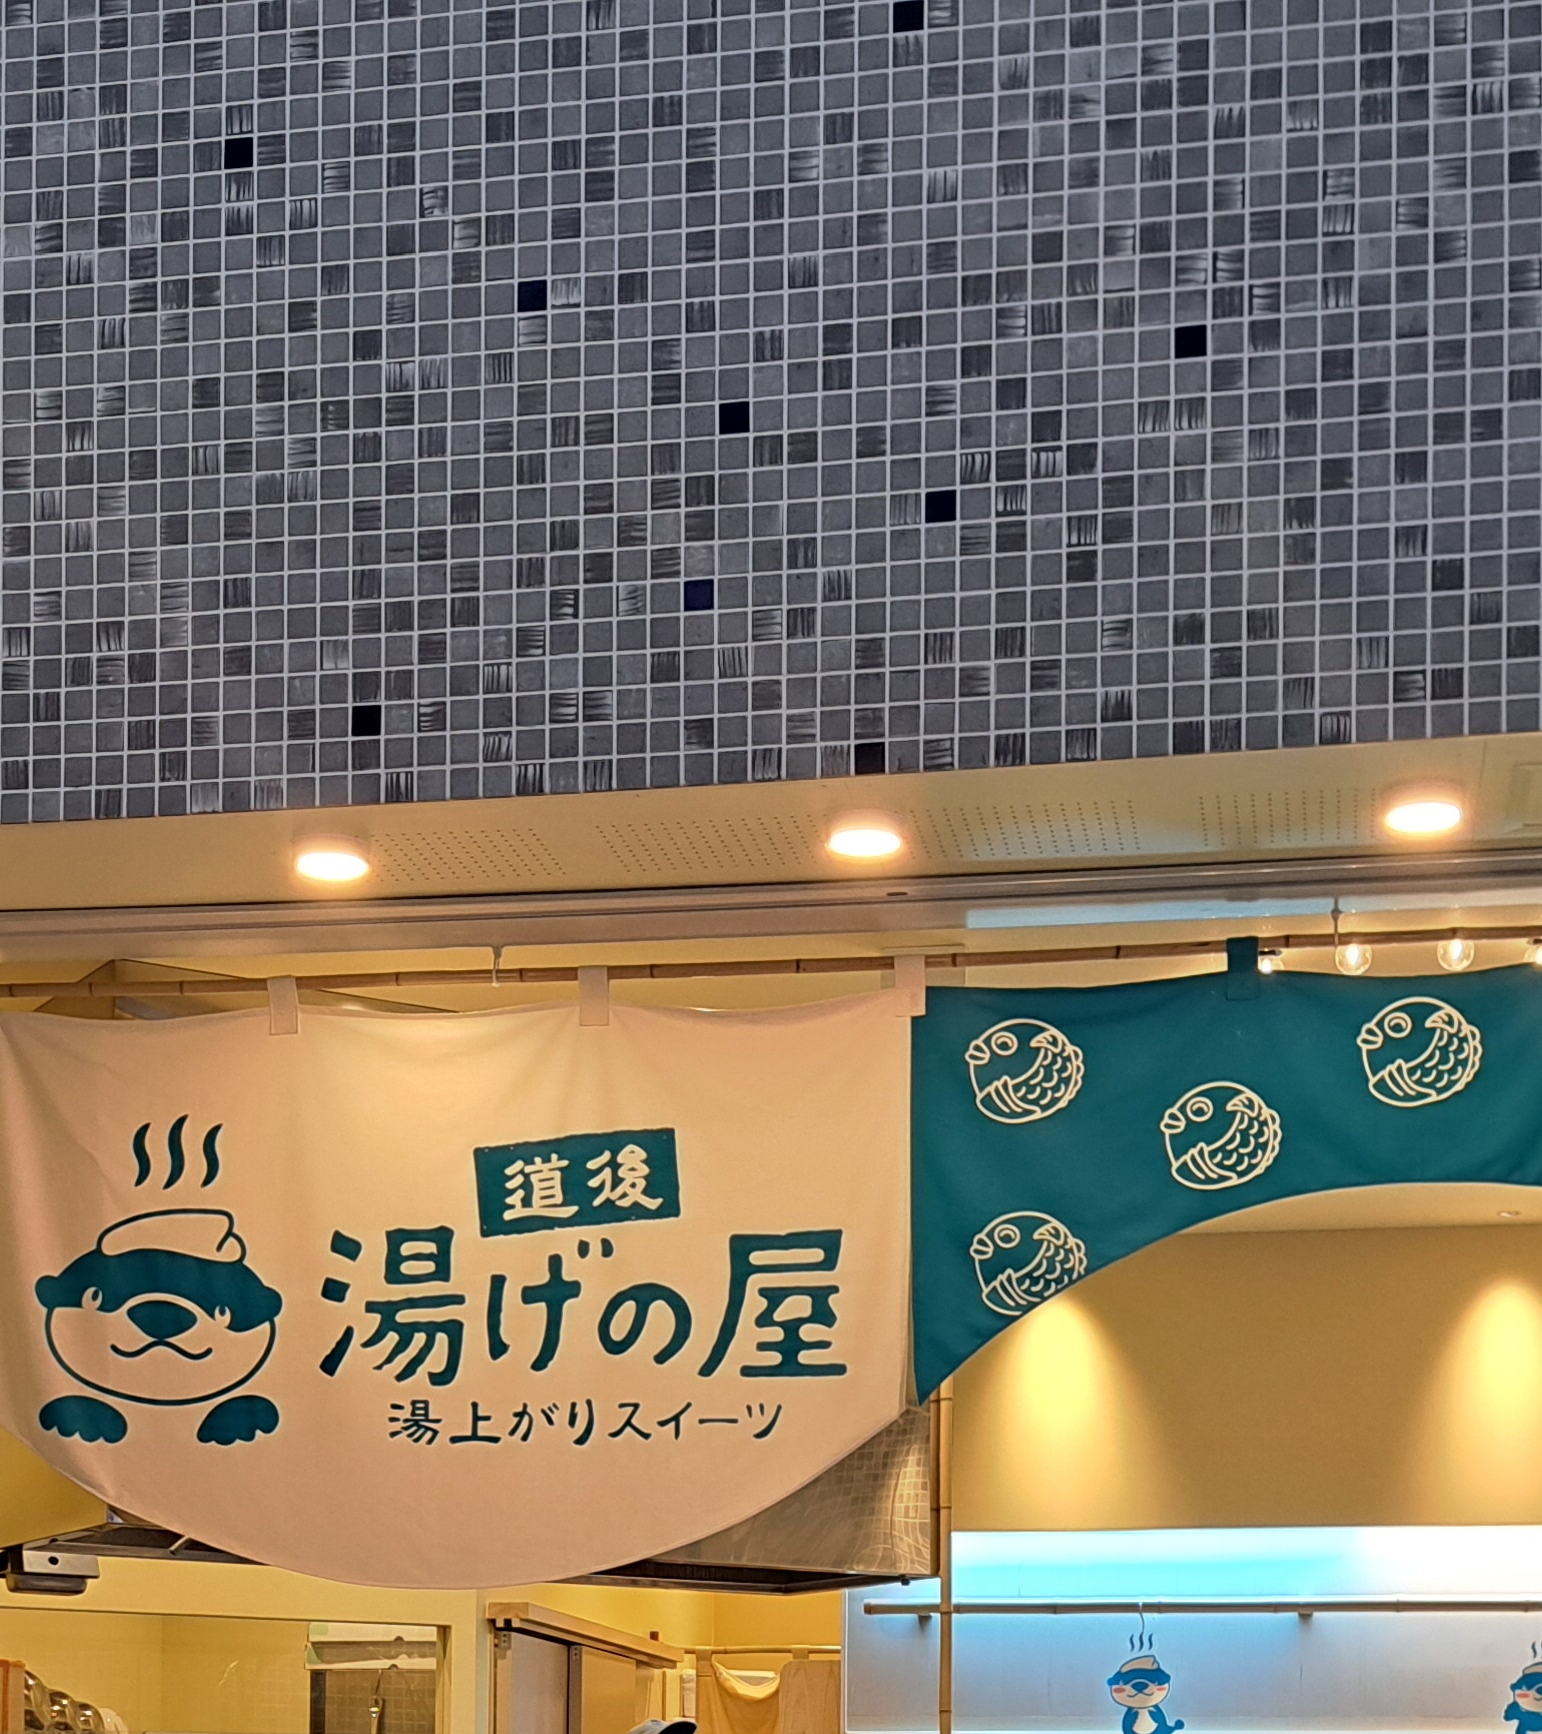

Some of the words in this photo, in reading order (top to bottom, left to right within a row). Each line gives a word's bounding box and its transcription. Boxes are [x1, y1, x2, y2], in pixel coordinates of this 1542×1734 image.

[502, 1142, 665, 1221] 道後
[317, 1224, 849, 1388] 湯げの屋
[388, 1398, 785, 1447] 湯上がりスイーツ
